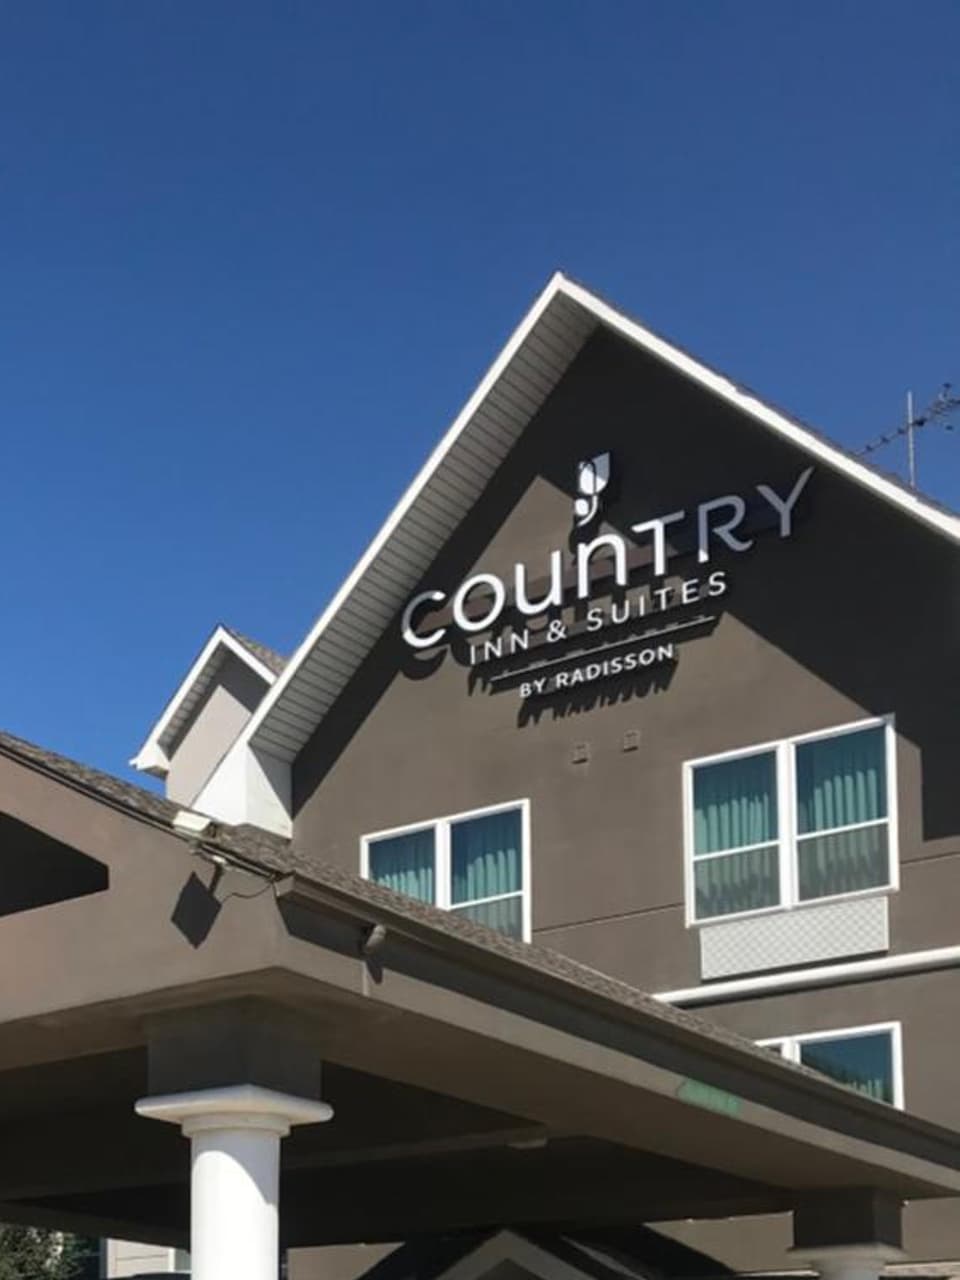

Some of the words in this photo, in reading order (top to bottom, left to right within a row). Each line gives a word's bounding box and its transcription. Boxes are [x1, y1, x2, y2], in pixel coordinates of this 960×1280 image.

[469, 629, 529, 665] INN
[546, 619, 567, 642] &
[586, 571, 727, 631] SUITES
[519, 676, 546, 698] BY
[555, 643, 675, 689] RADISSON
